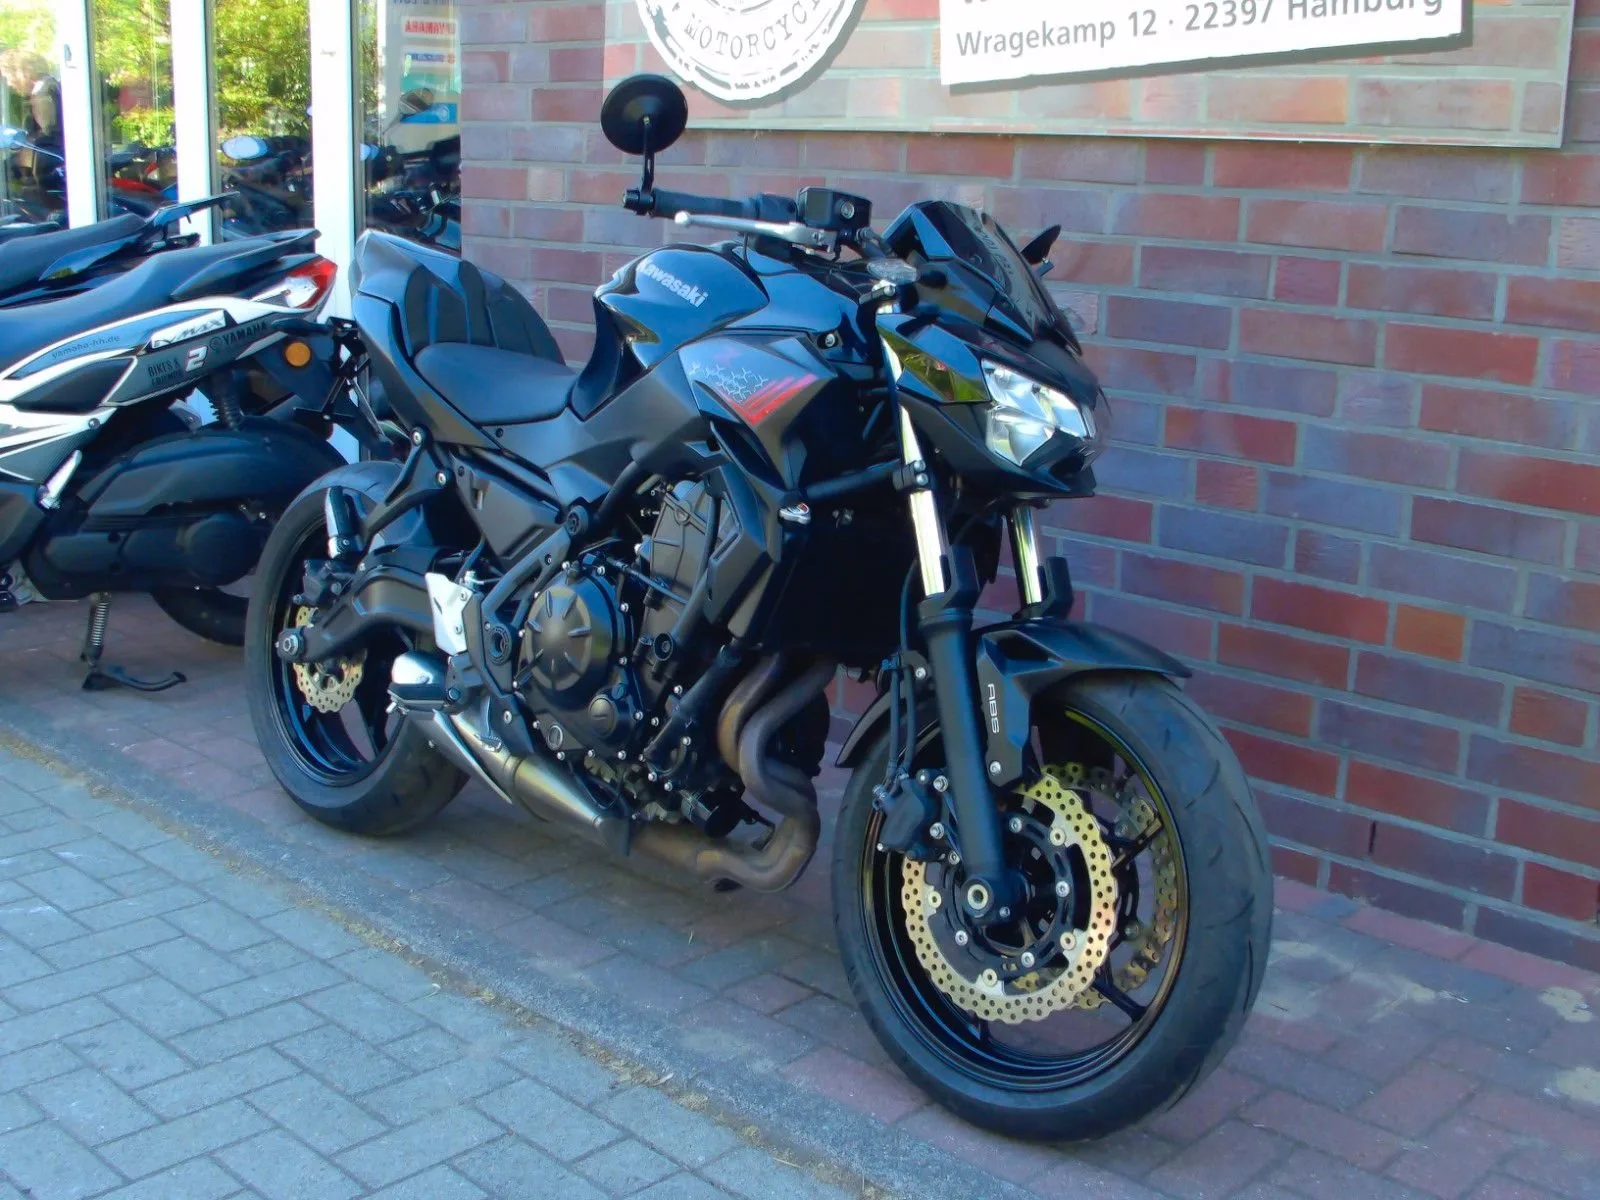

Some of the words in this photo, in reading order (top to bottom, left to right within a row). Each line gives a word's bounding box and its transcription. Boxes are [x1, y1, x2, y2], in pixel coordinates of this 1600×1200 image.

[956, 19, 1116, 58] Wragekamp
[1128, 9, 1157, 37] 12
[1184, 0, 1275, 32] 22397
[185, 345, 209, 373] 2
[987, 683, 1000, 734] ABS
